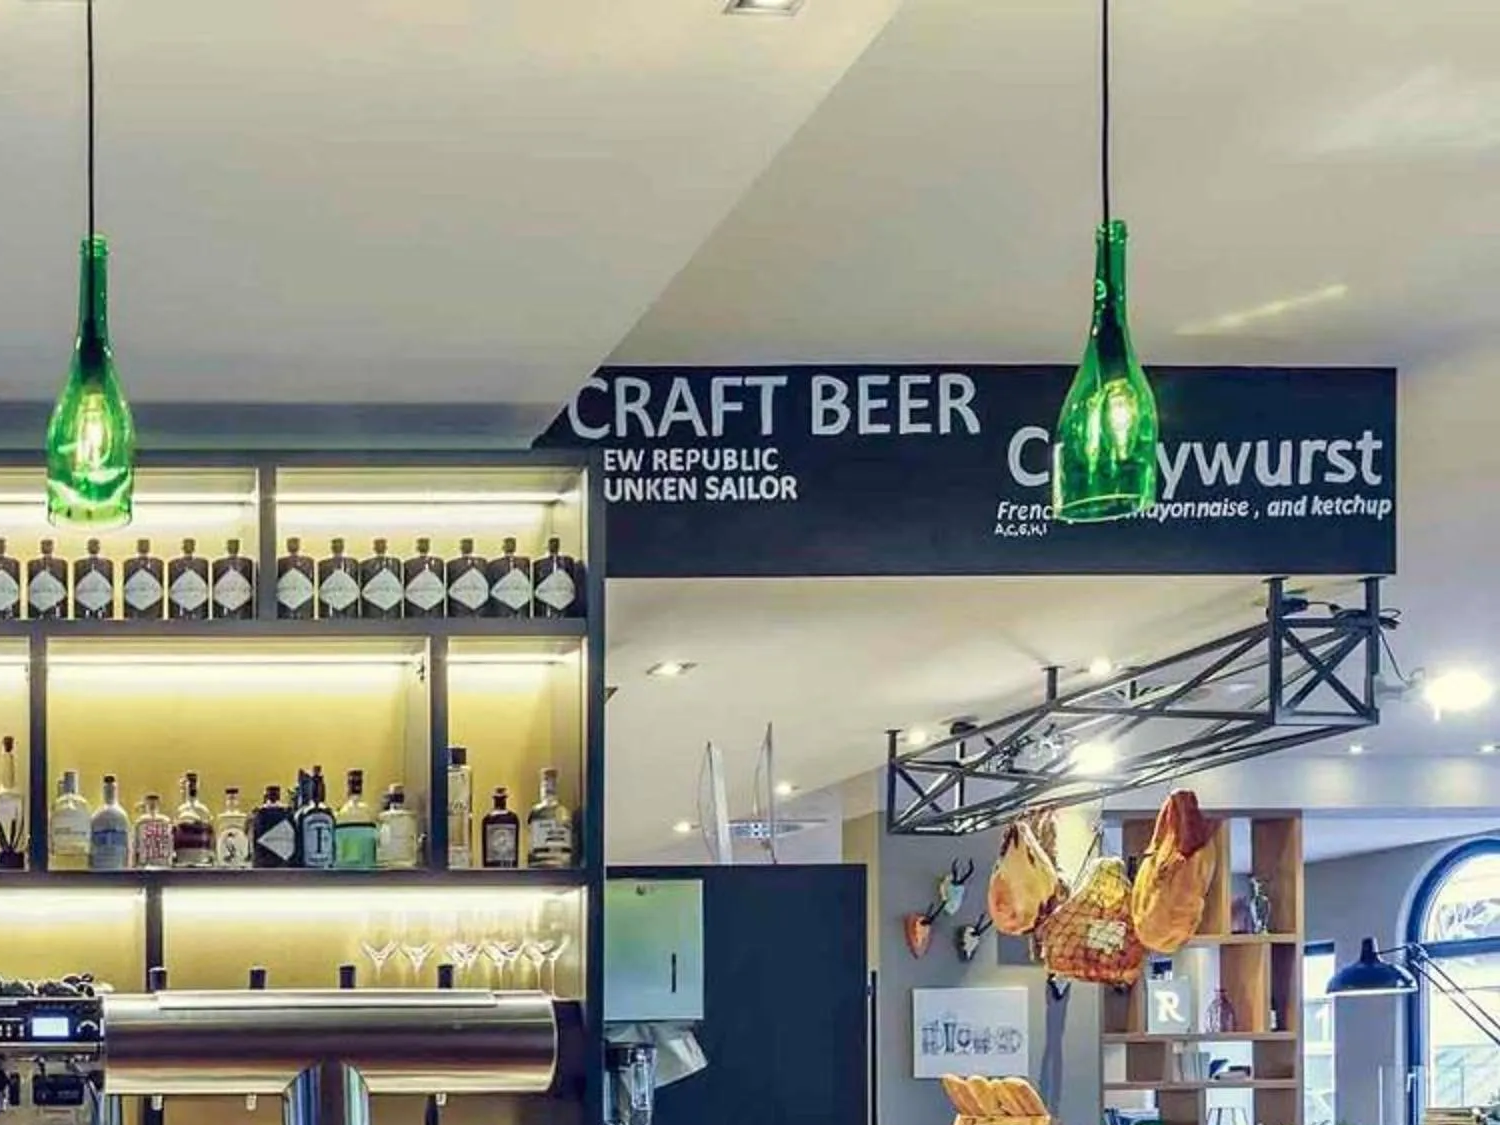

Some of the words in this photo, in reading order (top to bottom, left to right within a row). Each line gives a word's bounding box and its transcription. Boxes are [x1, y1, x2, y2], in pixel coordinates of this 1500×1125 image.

[568, 375, 788, 439] CRAFT
[811, 373, 980, 435] BEER
[652, 448, 779, 472] REPUBLIC
[1008, 426, 1383, 501] Cywurst
[704, 475, 798, 501] SAILOR
[997, 501, 1058, 520] Frenc
[1267, 496, 1306, 517] and
[1311, 494, 1392, 521] ketchup
